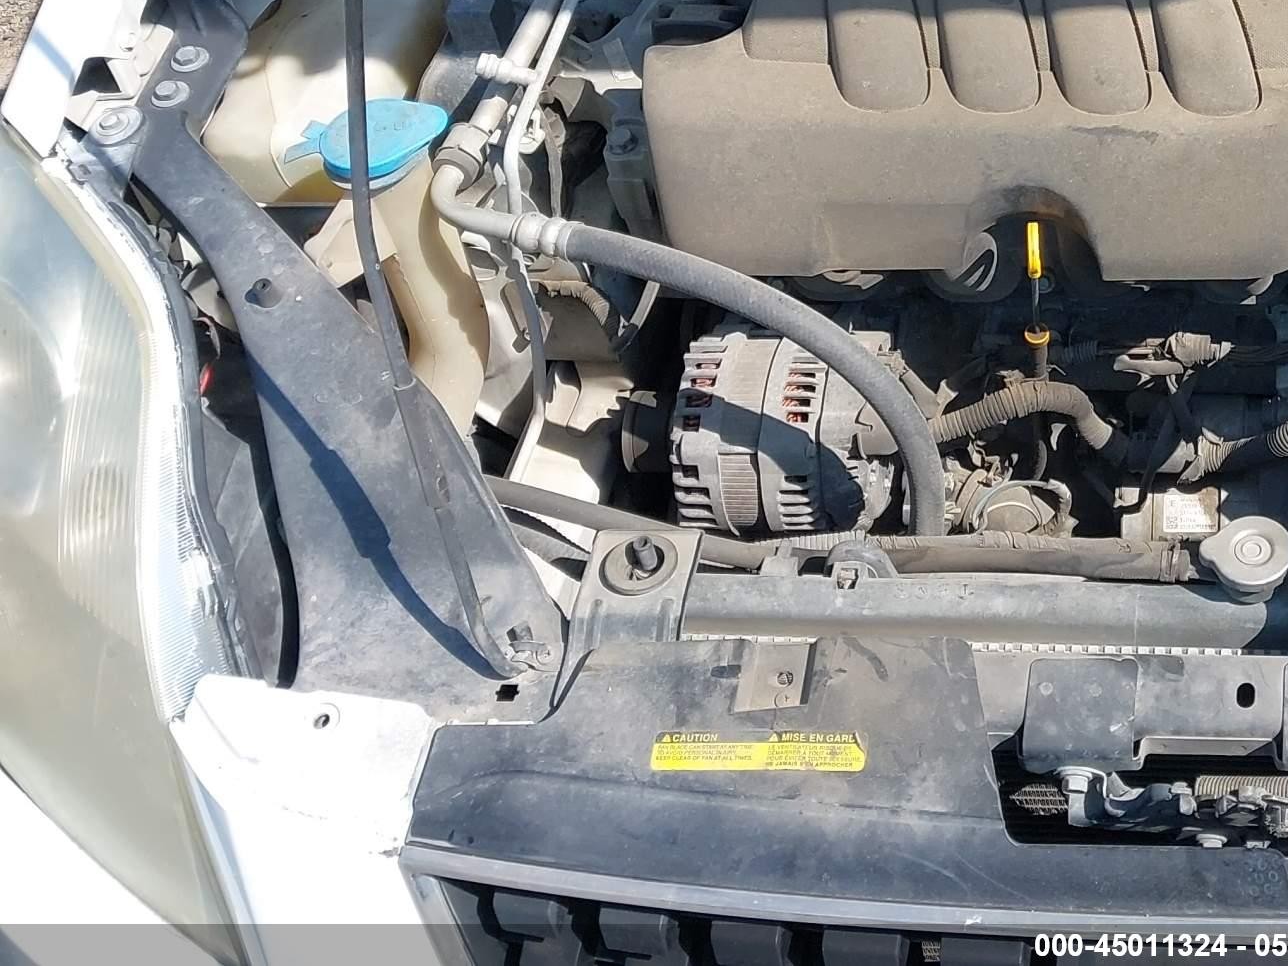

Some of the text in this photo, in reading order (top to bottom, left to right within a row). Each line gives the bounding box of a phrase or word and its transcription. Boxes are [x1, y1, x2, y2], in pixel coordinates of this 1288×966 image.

[672, 733, 718, 742] CAUTION
[781, 733, 806, 742] MISE
[809, 734, 825, 742] EN
